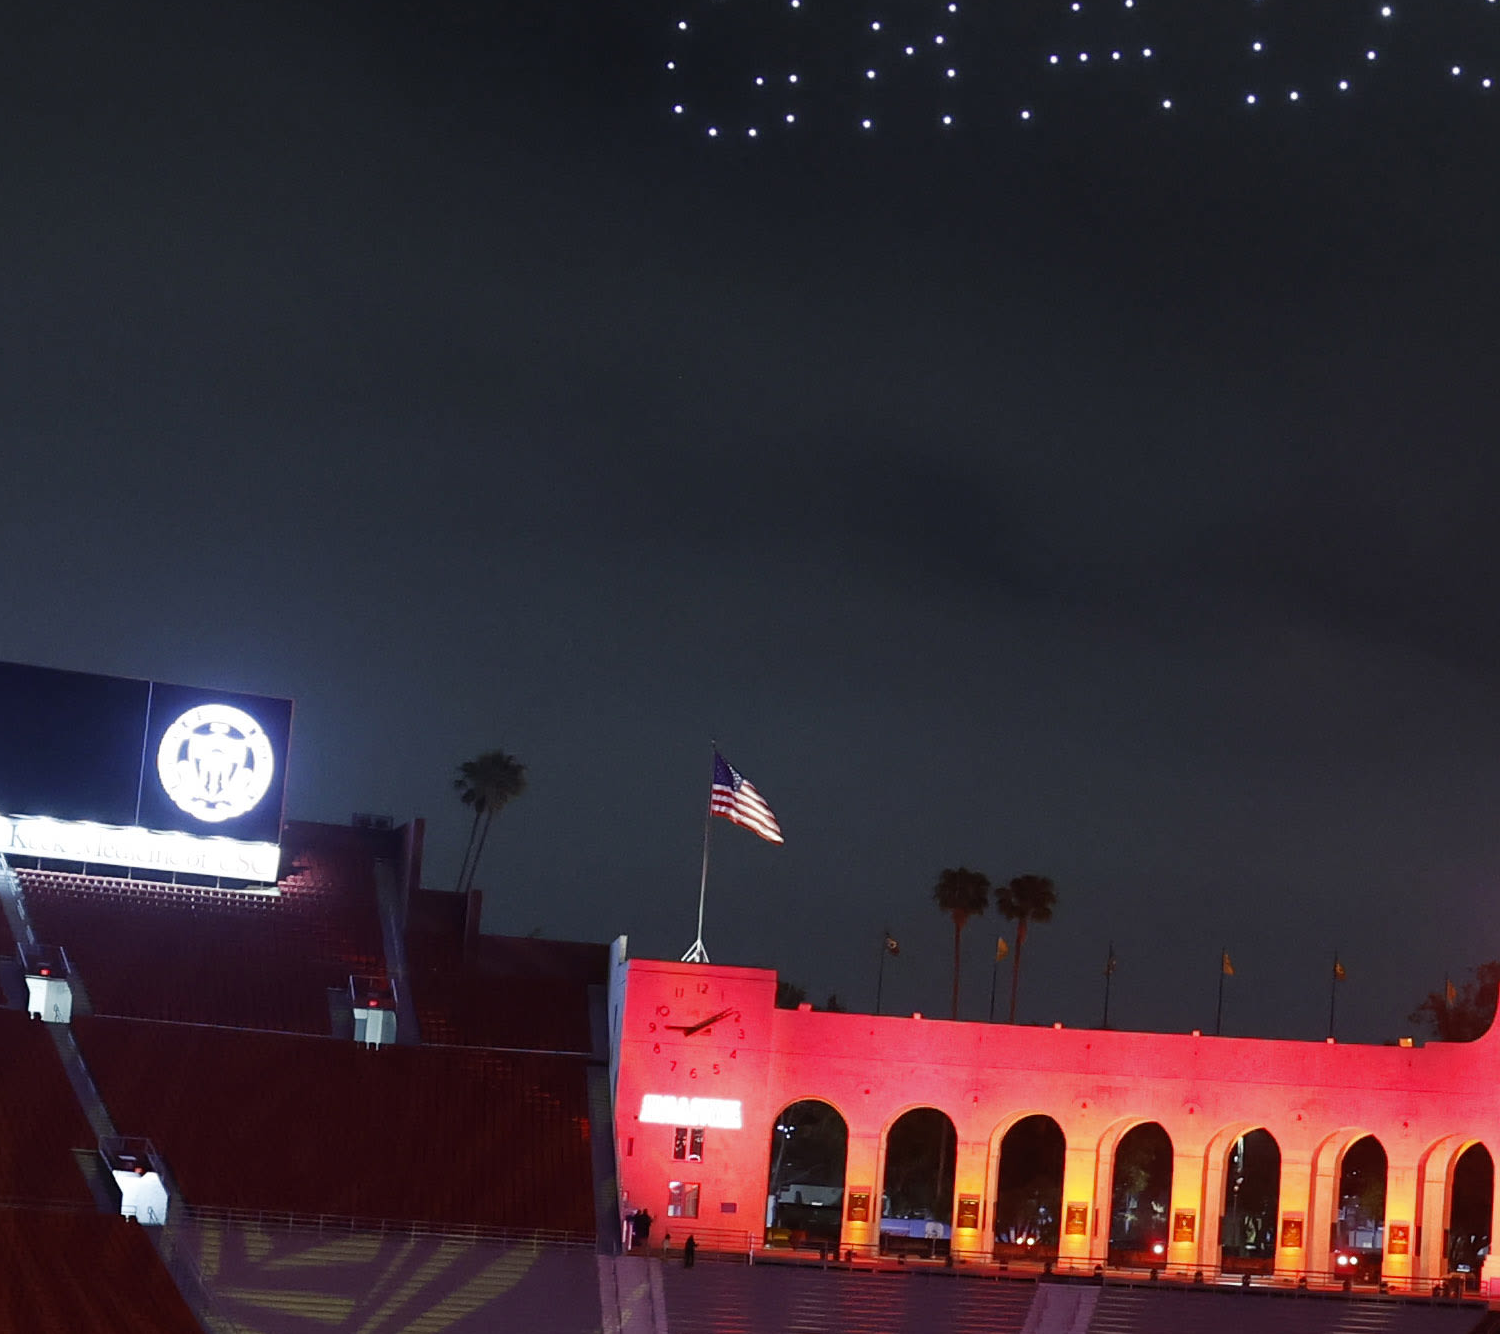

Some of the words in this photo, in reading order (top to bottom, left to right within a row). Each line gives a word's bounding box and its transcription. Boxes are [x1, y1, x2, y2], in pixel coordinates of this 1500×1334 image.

[675, 987, 684, 998] 11
[696, 983, 708, 994] 12
[655, 1005, 670, 1017] 10
[734, 1011, 741, 1023] 2
[649, 1022, 656, 1033] 9
[738, 1029, 745, 1040] 3
[729, 1050, 737, 1059] 4
[670, 1061, 677, 1072] 7
[713, 1064, 720, 1075] 5
[690, 1068, 698, 1079] 6
